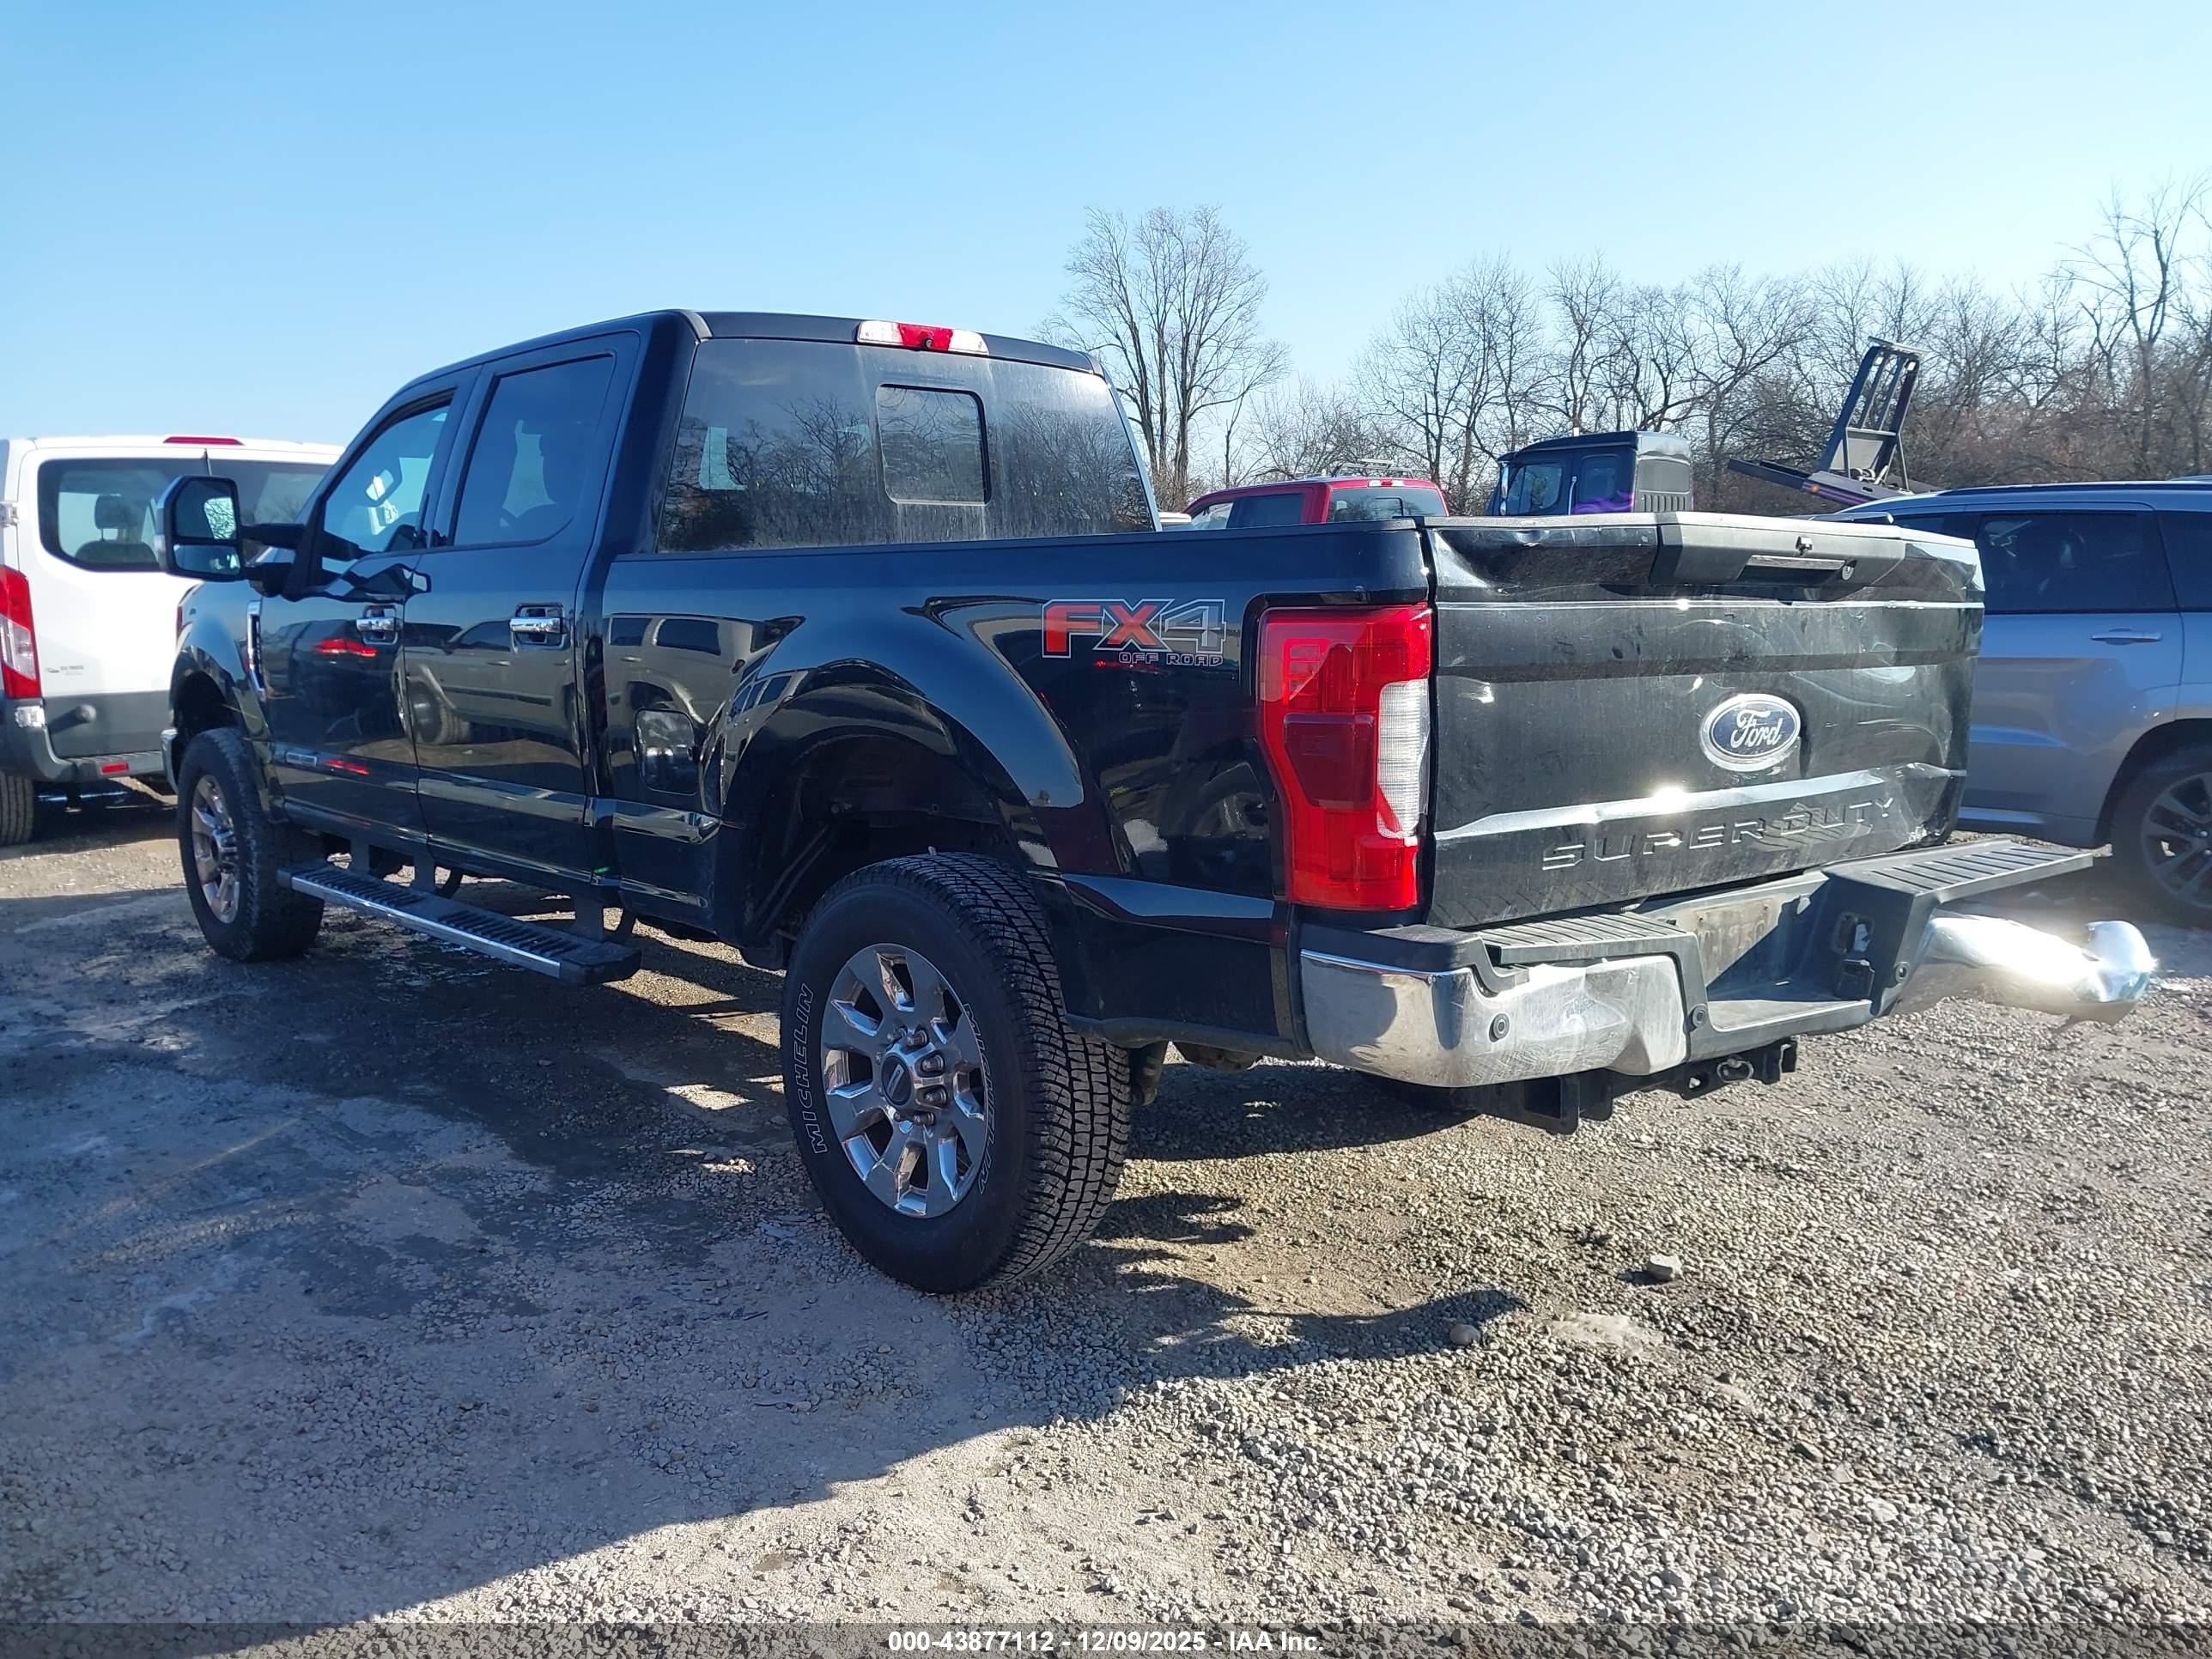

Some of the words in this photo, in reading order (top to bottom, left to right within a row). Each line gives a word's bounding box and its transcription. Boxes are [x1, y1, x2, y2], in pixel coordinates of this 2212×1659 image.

[1042, 598, 1226, 659] FX4
[1119, 652, 1158, 665] OFF
[1166, 653, 1223, 666] ROAD
[1730, 709, 1784, 748] Ford
[1542, 817, 1765, 870] SUPER
[1780, 797, 1895, 836] DUTY
[794, 983, 828, 1153] MICHELIN
